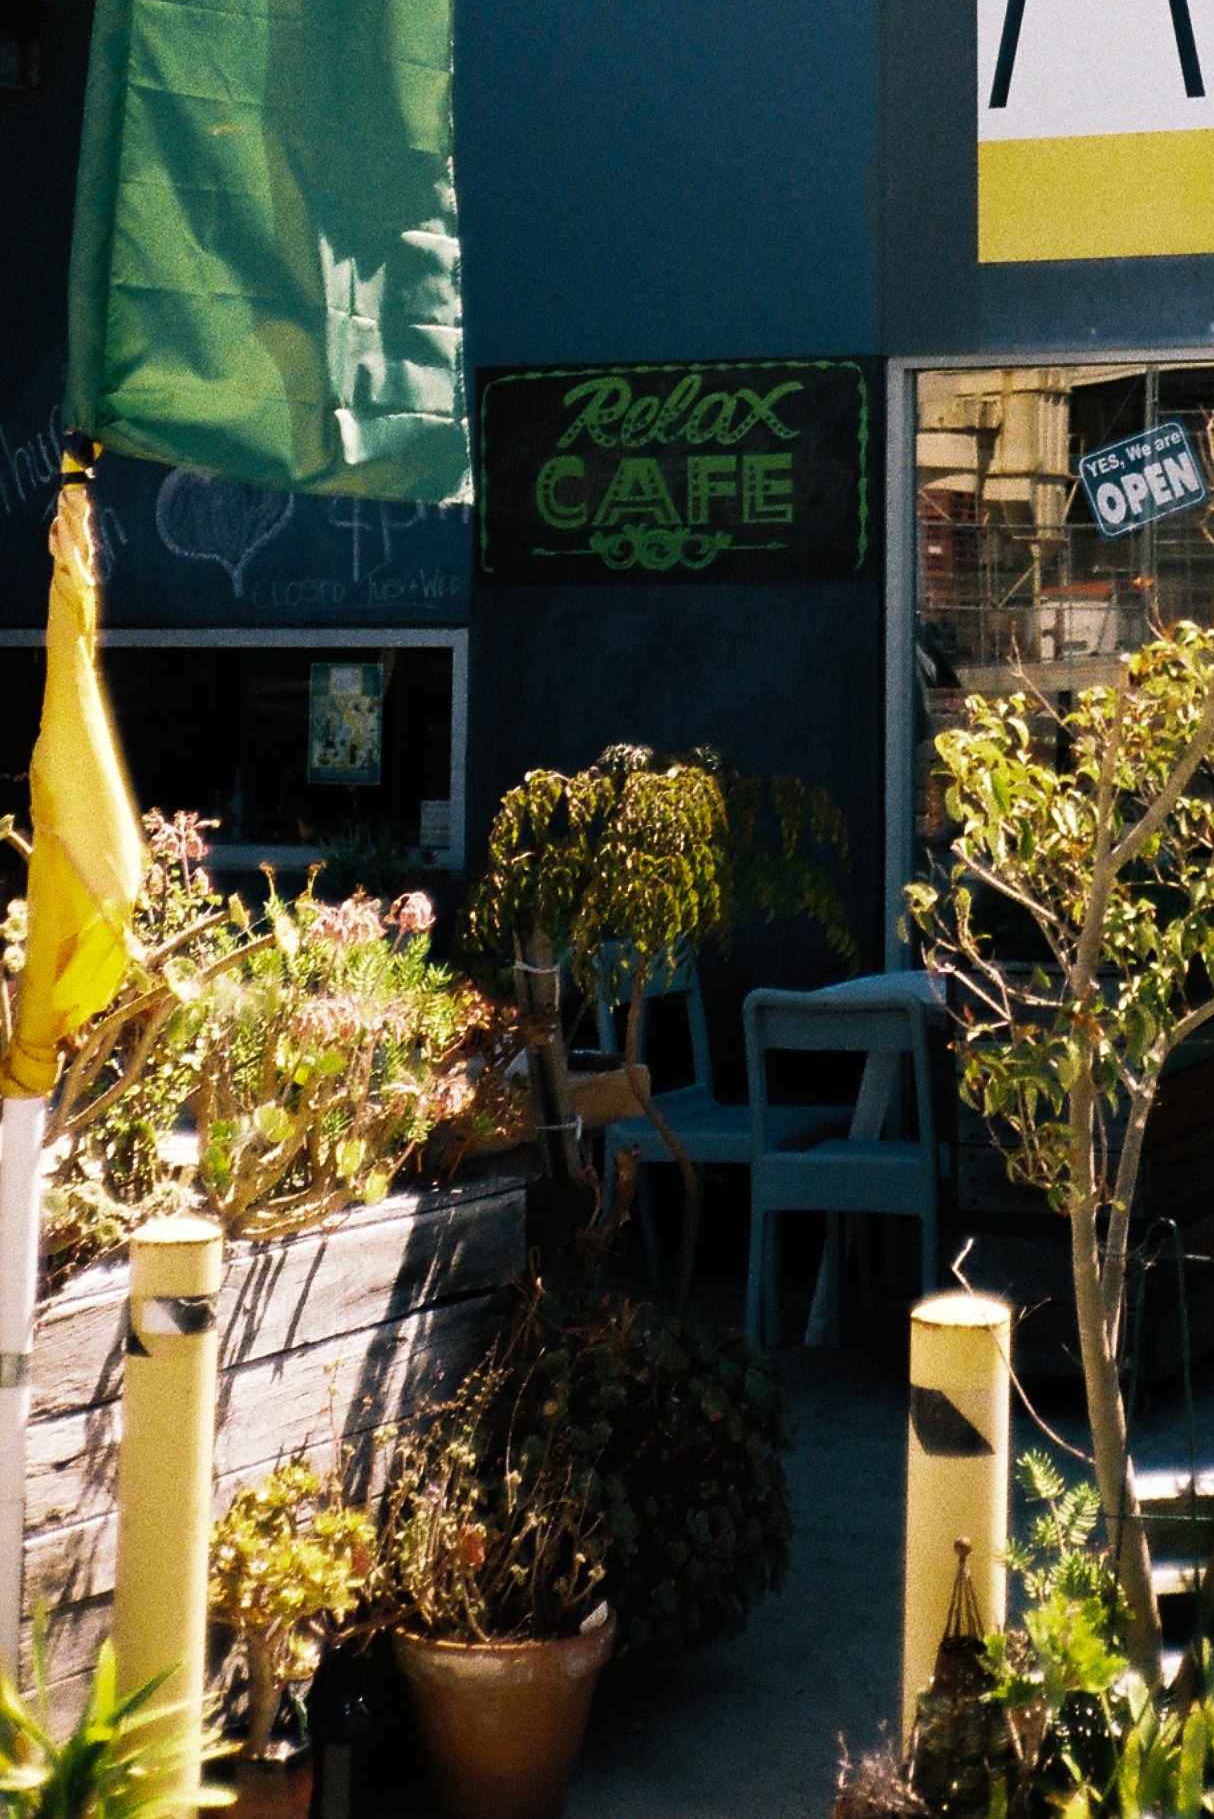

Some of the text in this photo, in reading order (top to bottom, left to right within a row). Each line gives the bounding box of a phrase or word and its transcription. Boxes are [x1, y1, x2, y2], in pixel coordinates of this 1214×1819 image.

[556, 373, 803, 449] Relax
[535, 452, 794, 529] CAFE
[1086, 432, 1181, 478] YES, We are
[1097, 451, 1200, 524] OPEN
